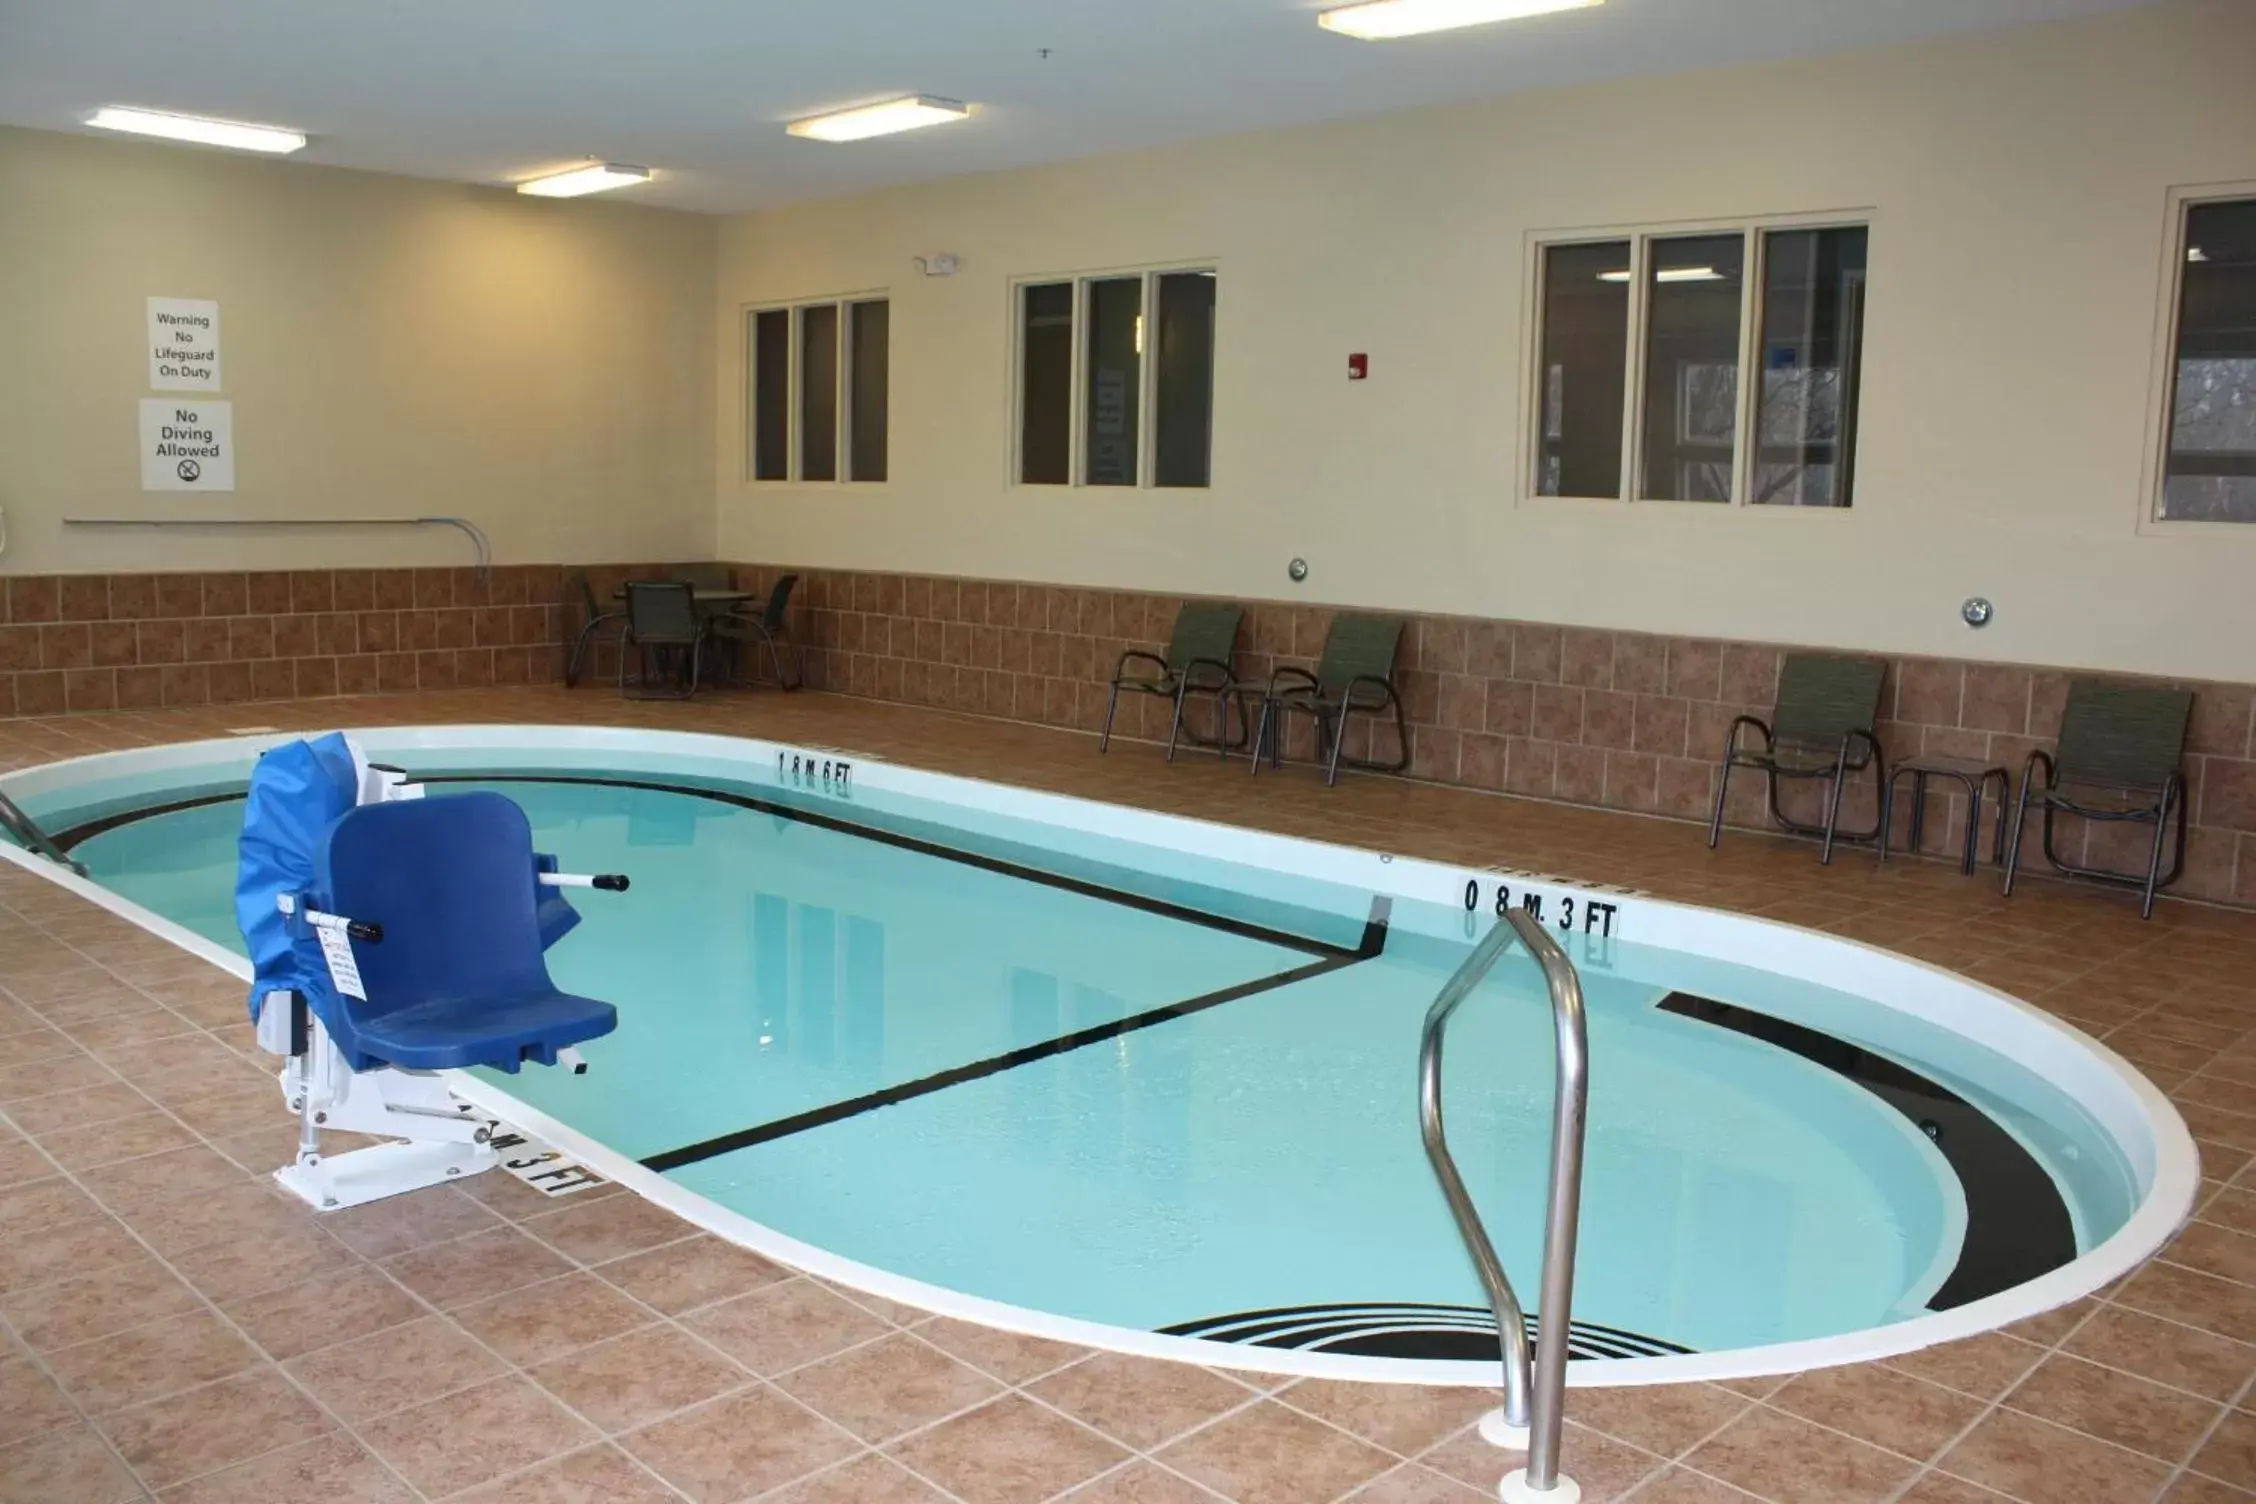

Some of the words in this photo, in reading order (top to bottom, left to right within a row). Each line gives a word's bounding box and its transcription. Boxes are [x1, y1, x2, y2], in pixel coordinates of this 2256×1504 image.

[156, 312, 210, 329] Warning
[175, 331, 193, 343] No
[155, 348, 214, 362] Lifeguard
[159, 365, 178, 376] On
[181, 366, 211, 380] Duty
[175, 409, 198, 423] No
[161, 426, 213, 444] Diving
[156, 443, 220, 458] Allowed
[835, 762, 850, 783] FT
[1559, 897, 1574, 930] 3
[1585, 901, 1617, 937] FT
[506, 1152, 562, 1169] 3
[528, 1165, 607, 1192] FT
